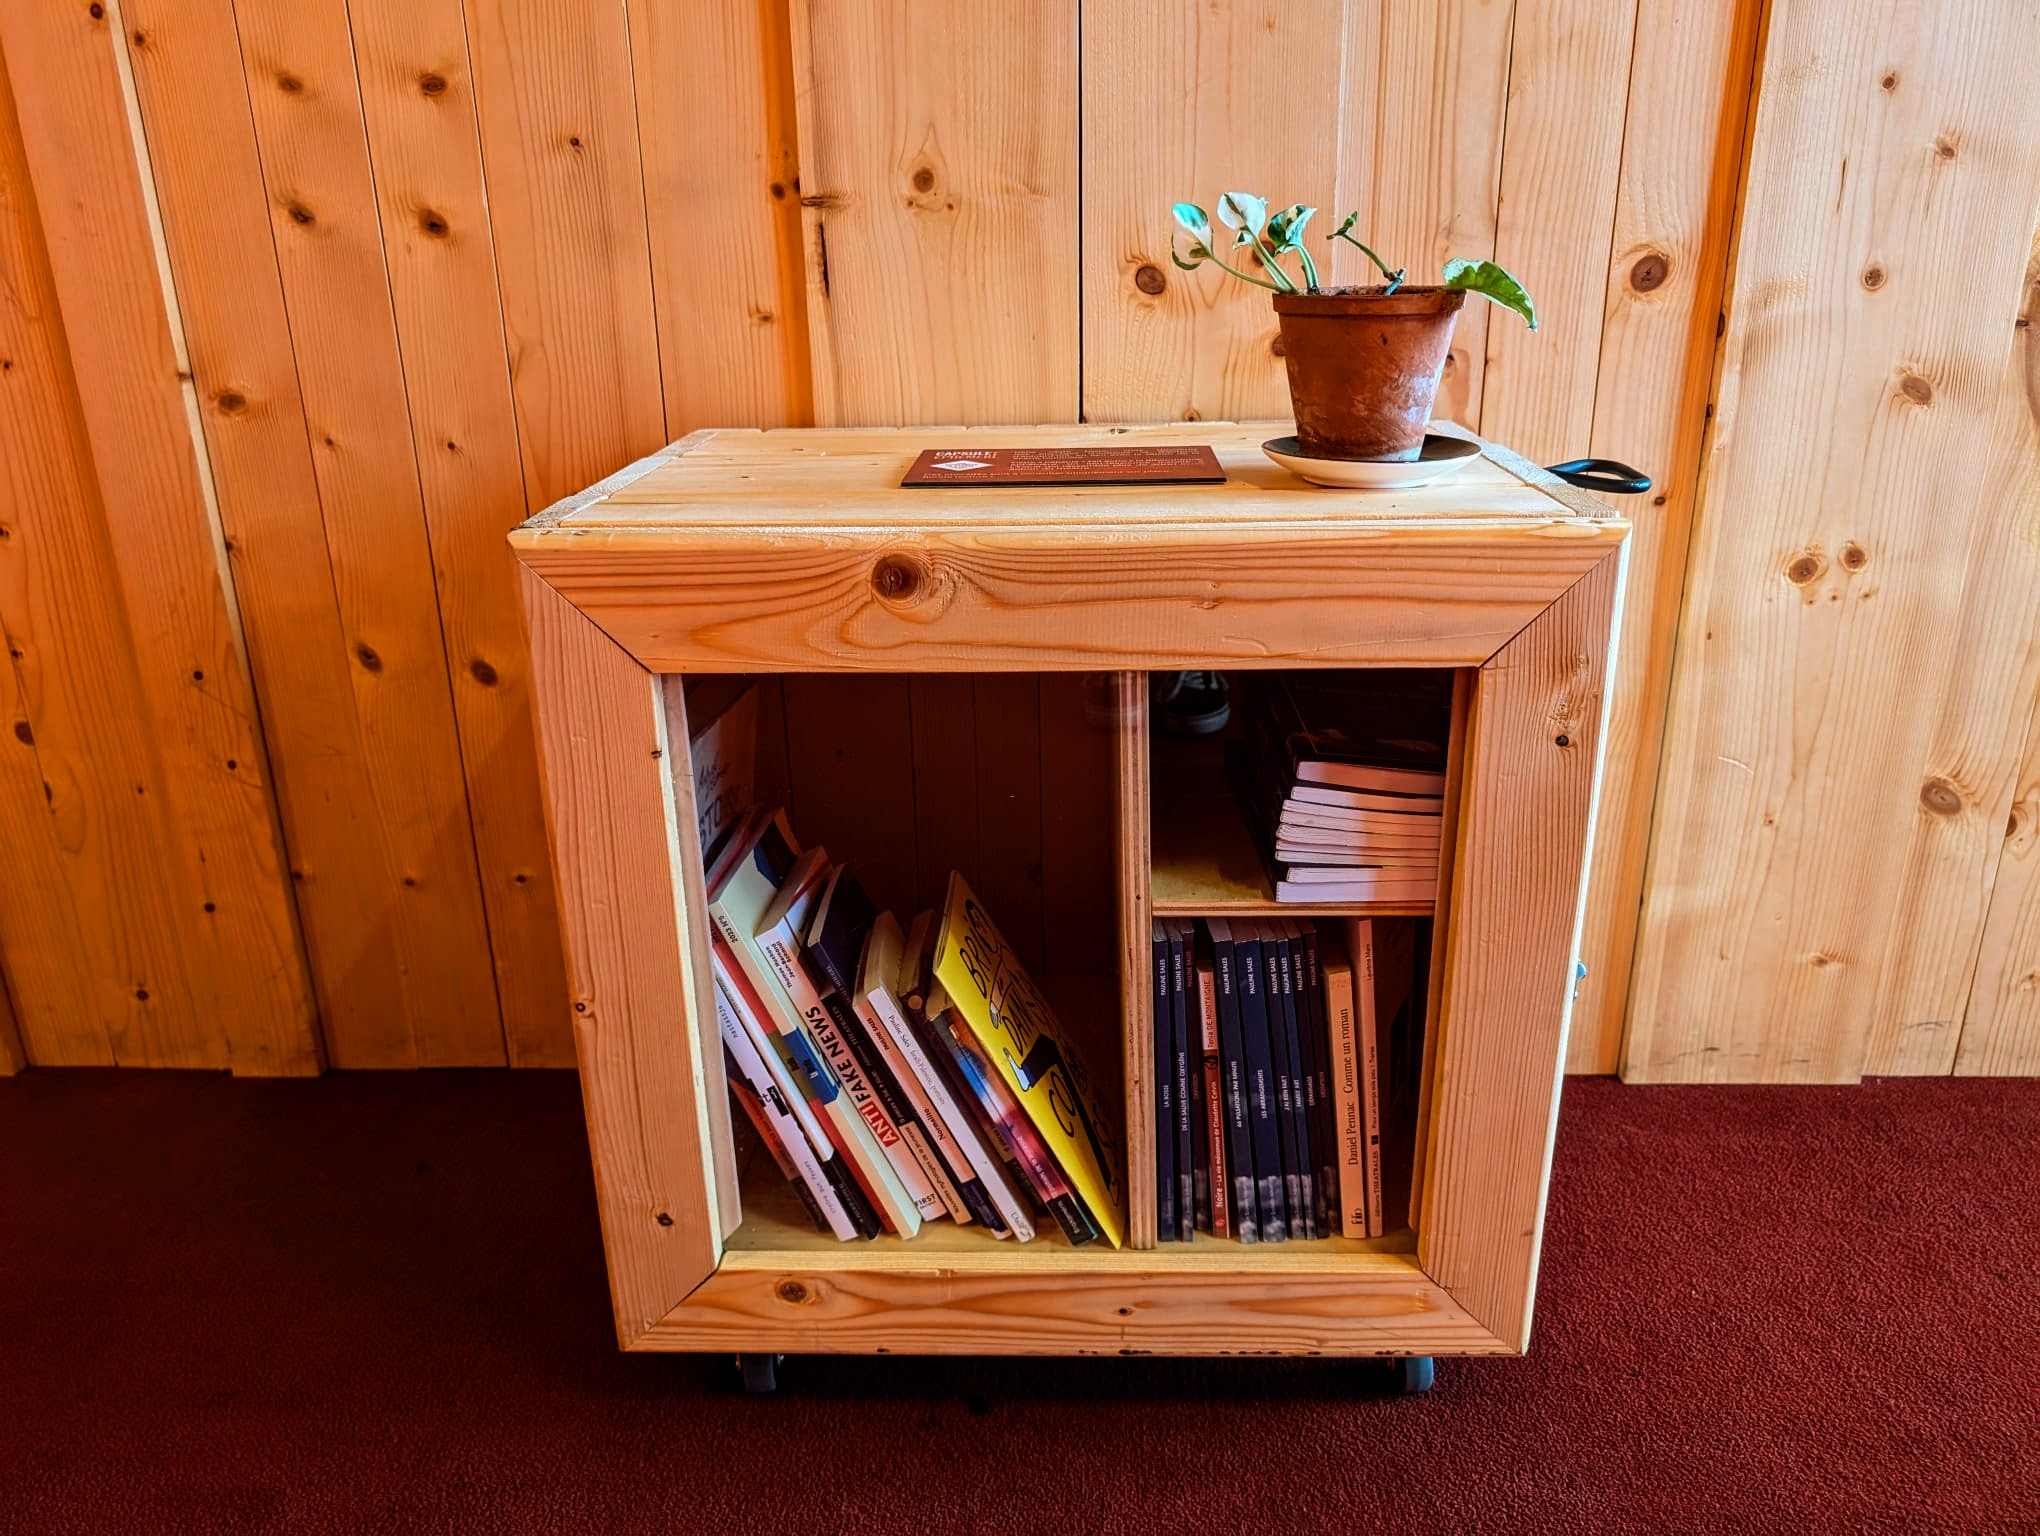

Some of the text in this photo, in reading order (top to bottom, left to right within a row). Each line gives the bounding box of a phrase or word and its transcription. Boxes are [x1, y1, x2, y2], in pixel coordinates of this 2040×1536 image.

[725, 927, 738, 944] 2023
[1203, 981, 1212, 1020] MONTAIGNE
[805, 1006, 844, 1058] NEWS
[866, 1017, 890, 1051] PAULINE SALES
[888, 1014, 911, 1048] Pauline Sales
[838, 1058, 871, 1103] FAKE
[1340, 1008, 1359, 1166] Daniel Pennac Comme un roman
[865, 1110, 896, 1144] ANTI
[922, 1107, 946, 1140] Normalito
[1211, 1100, 1220, 1128] Claudette
[1215, 1188, 1224, 1208] Noire
